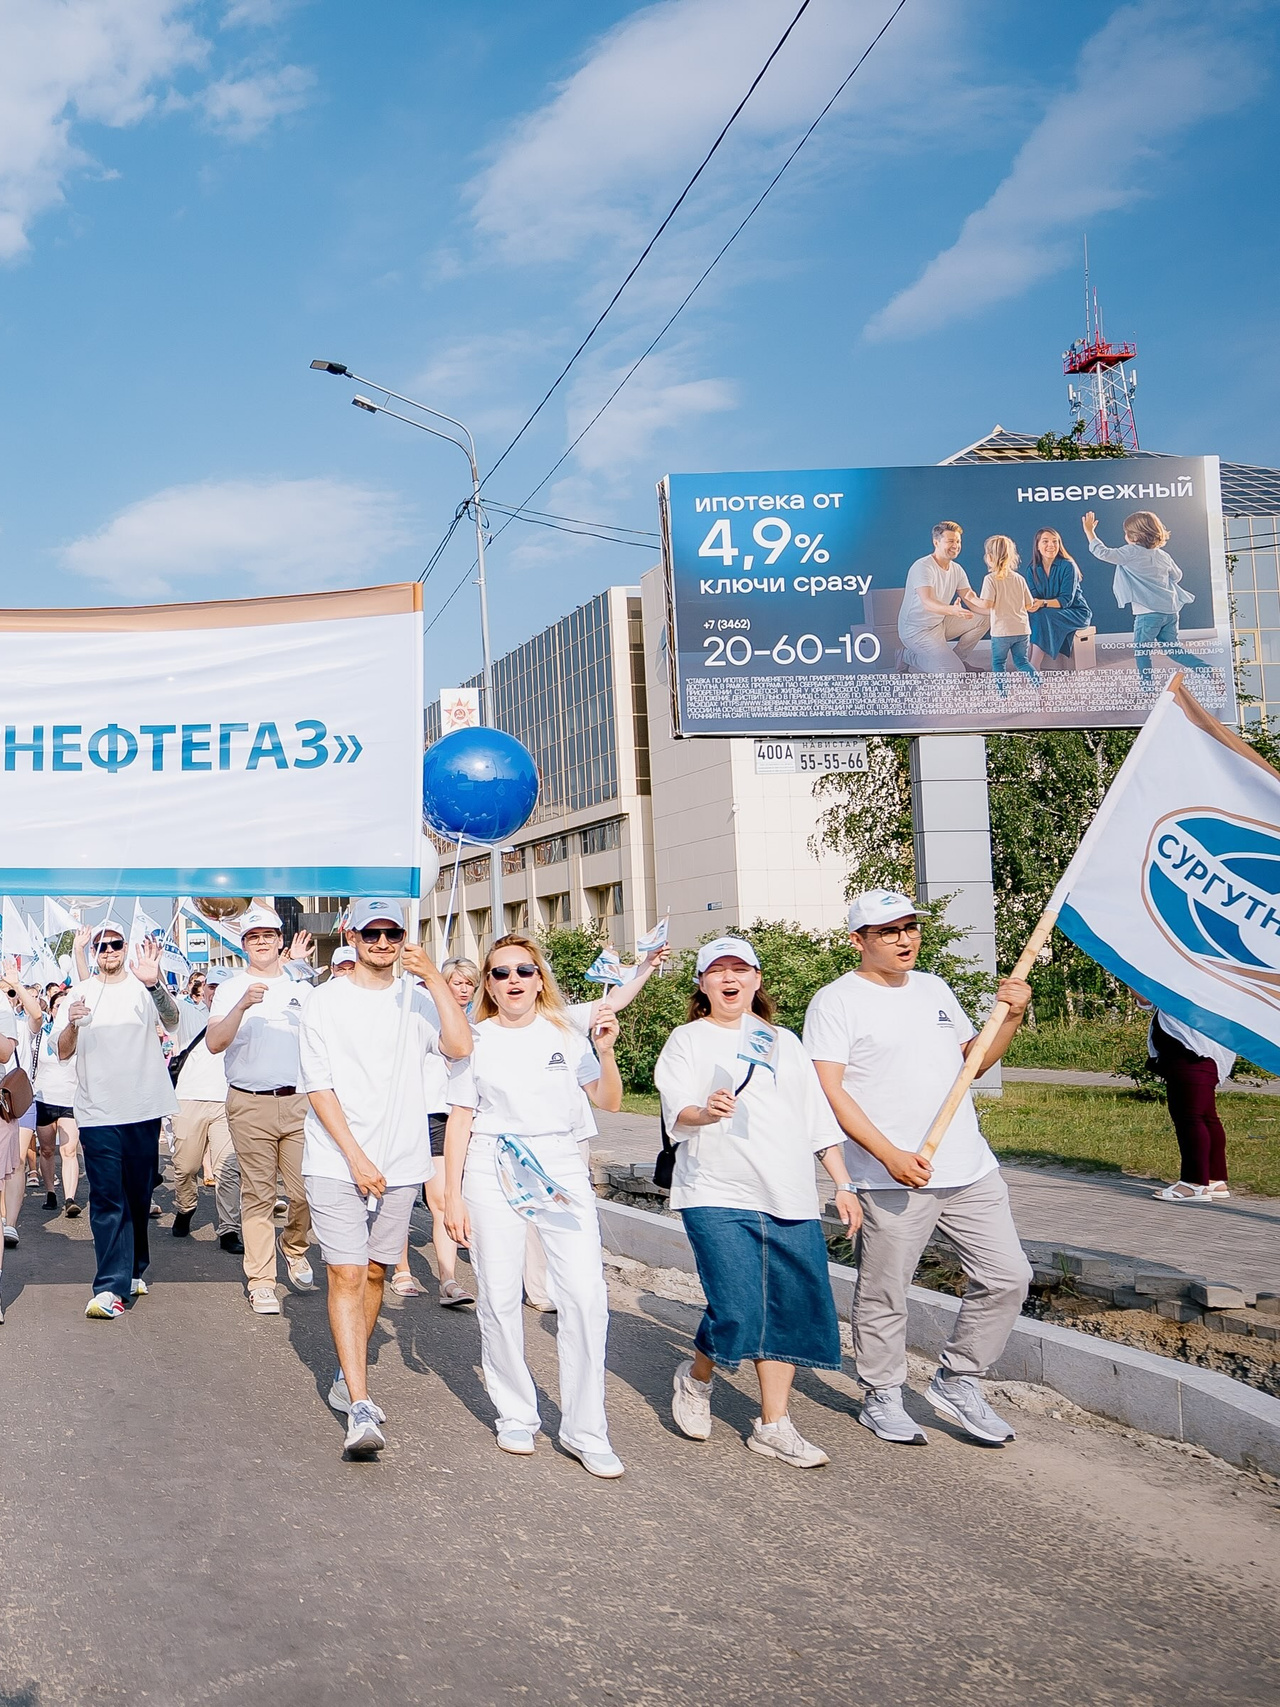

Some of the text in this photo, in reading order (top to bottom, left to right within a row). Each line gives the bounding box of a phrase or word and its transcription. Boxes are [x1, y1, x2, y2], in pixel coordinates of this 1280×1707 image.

[1017, 475, 1193, 503] набережный
[694, 492, 844, 513] ипотека от
[698, 517, 830, 571] 4,9%
[699, 574, 873, 597] ключи сразу
[703, 618, 751, 631] +7 (3462)
[702, 632, 881, 667] 20-60-10
[1134, 649, 1174, 657] ДЕКЛАРАЦИЯ
[1186, 640, 1222, 648] ПРОЕКТНАЯ
[802, 740, 859, 749] НАВИСТАР
[800, 753, 864, 770] 55-55-66
